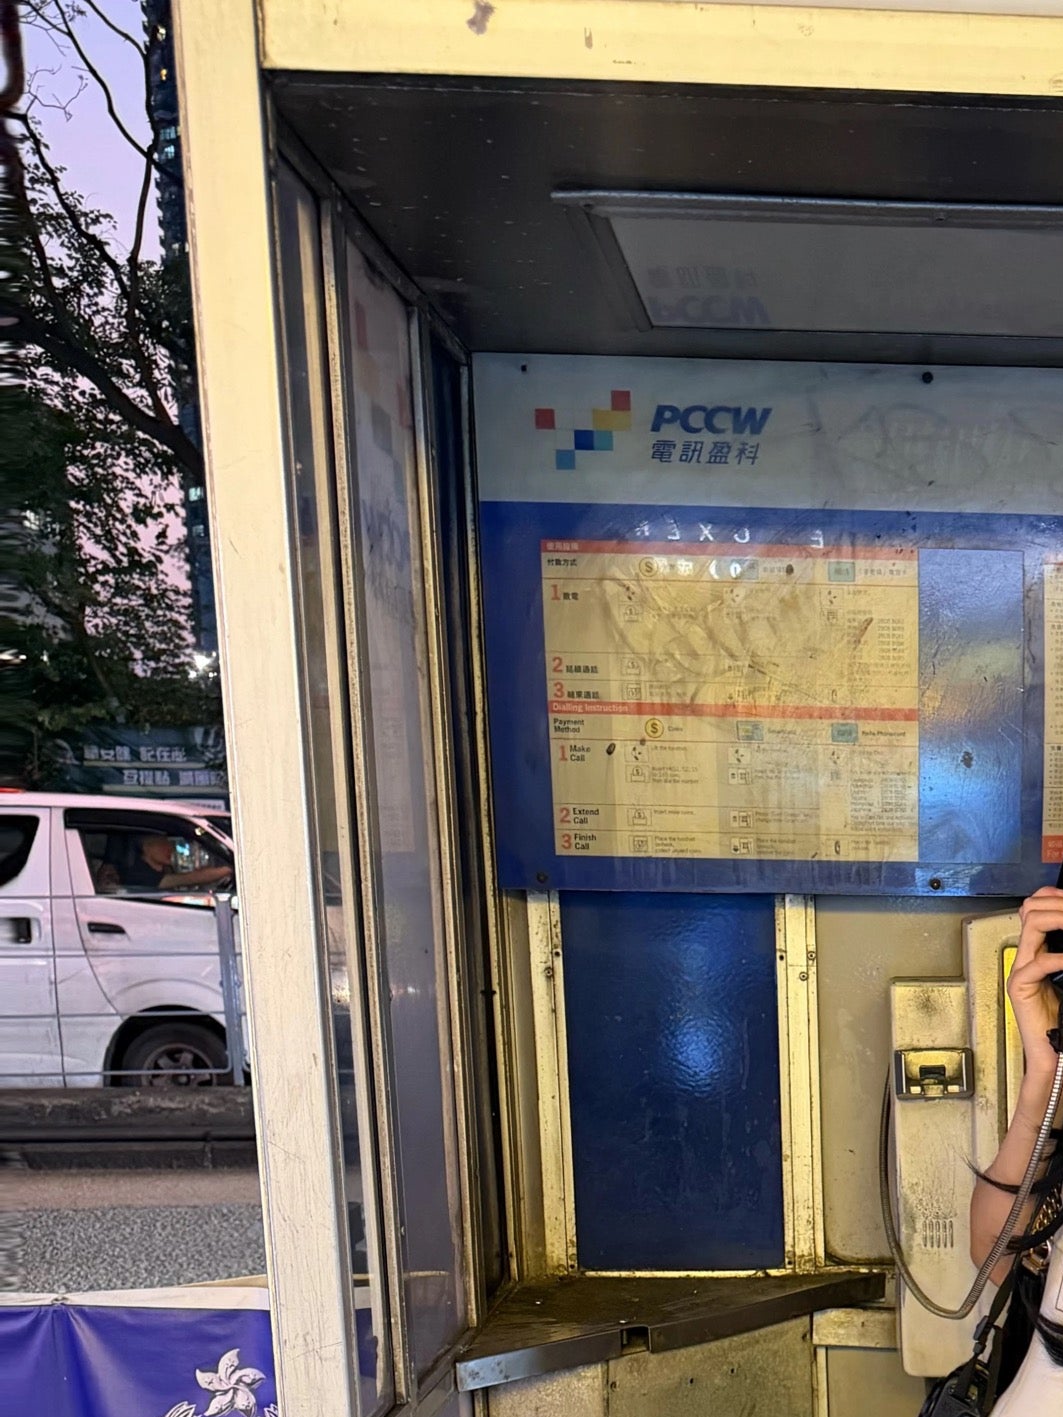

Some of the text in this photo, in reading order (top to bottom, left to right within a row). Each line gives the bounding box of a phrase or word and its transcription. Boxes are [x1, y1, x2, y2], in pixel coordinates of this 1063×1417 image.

[650, 404, 773, 435] PCCW
[650, 439, 761, 467] 電訊盈科
[551, 584, 561, 600] 1
[552, 656, 564, 673] 2
[553, 682, 565, 698] 3
[552, 702, 629, 713] Dialling Instruction
[553, 718, 585, 727] Payment
[554, 726, 581, 734] Method
[559, 744, 591, 761] 1 Make
[570, 753, 586, 762] Call
[559, 807, 599, 823] 2 Extend
[573, 817, 588, 825] Call
[561, 833, 597, 849] 3 Finish
[575, 842, 590, 850] Call
